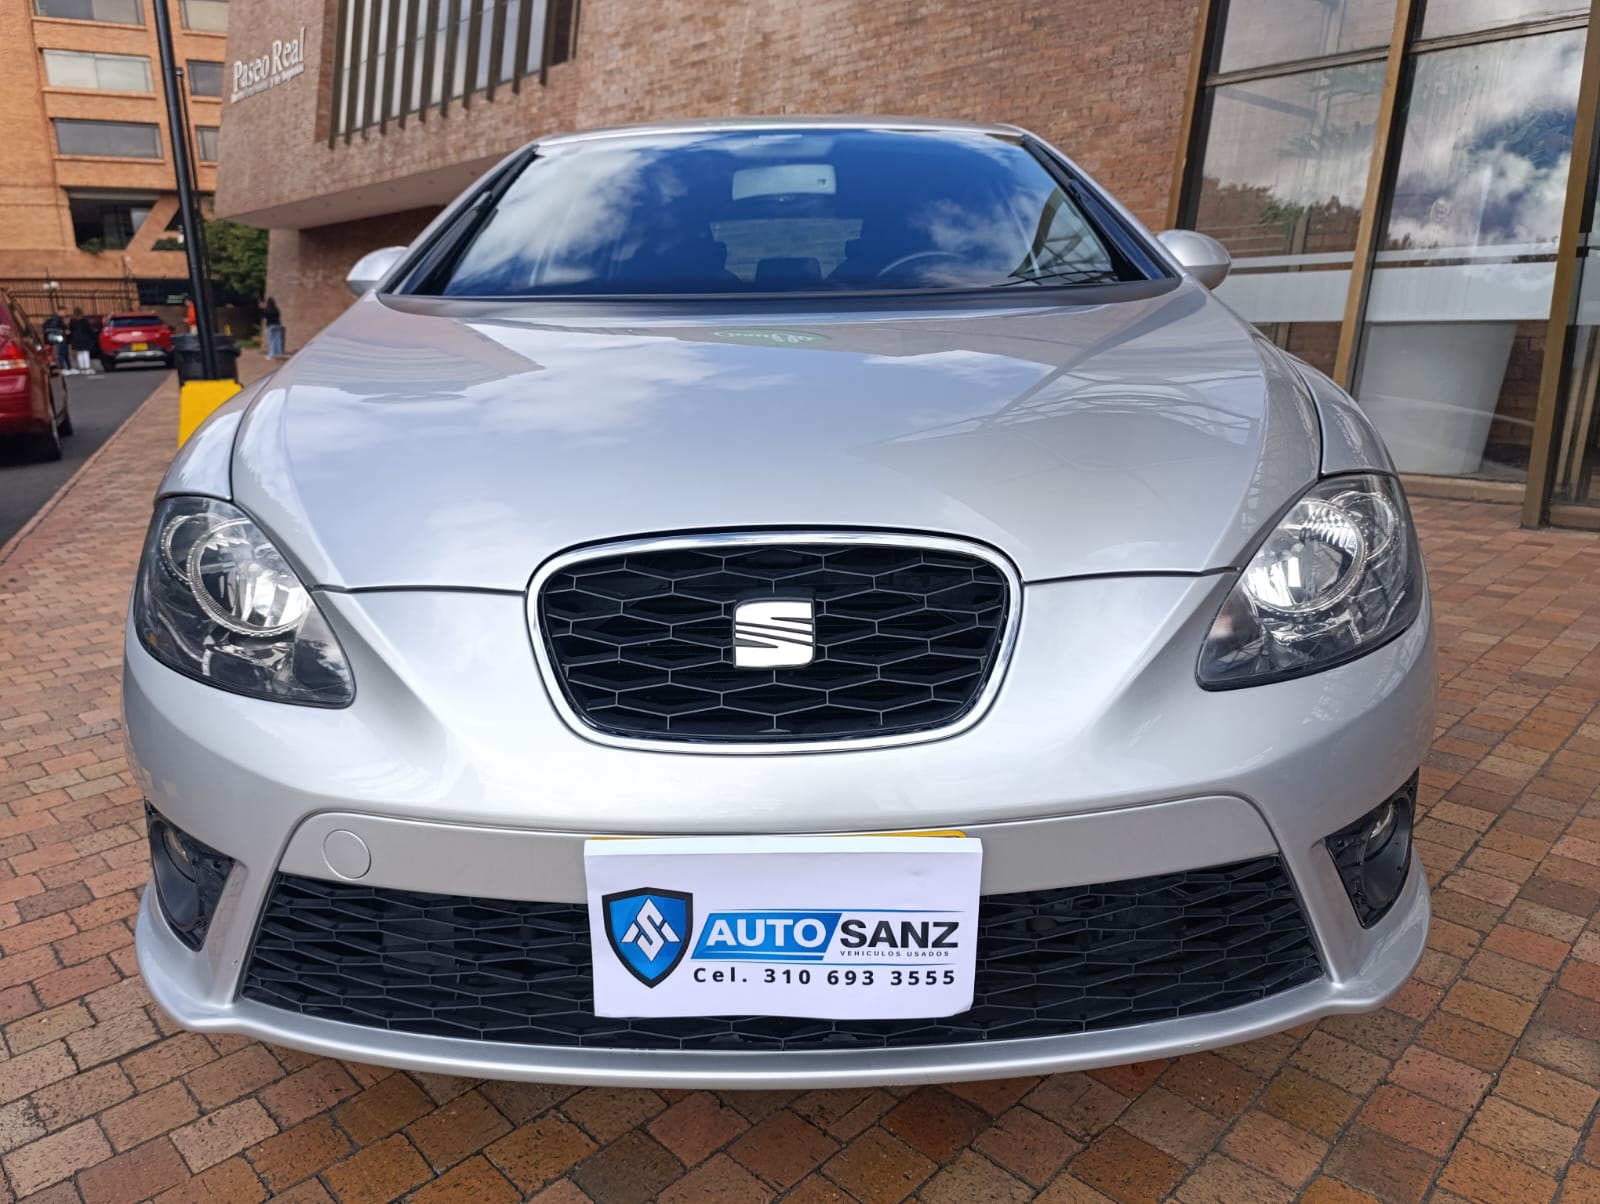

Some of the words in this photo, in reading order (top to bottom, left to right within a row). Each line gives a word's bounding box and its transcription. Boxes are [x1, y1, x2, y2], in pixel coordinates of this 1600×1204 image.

[233, 55, 270, 92] Paseo
[272, 26, 305, 75] Real
[705, 918, 827, 948] AUTO
[840, 919, 960, 949] SANZ
[693, 966, 748, 983] Cel.
[763, 968, 811, 985] 310
[827, 970, 874, 986] 693
[890, 970, 955, 986] 3555
